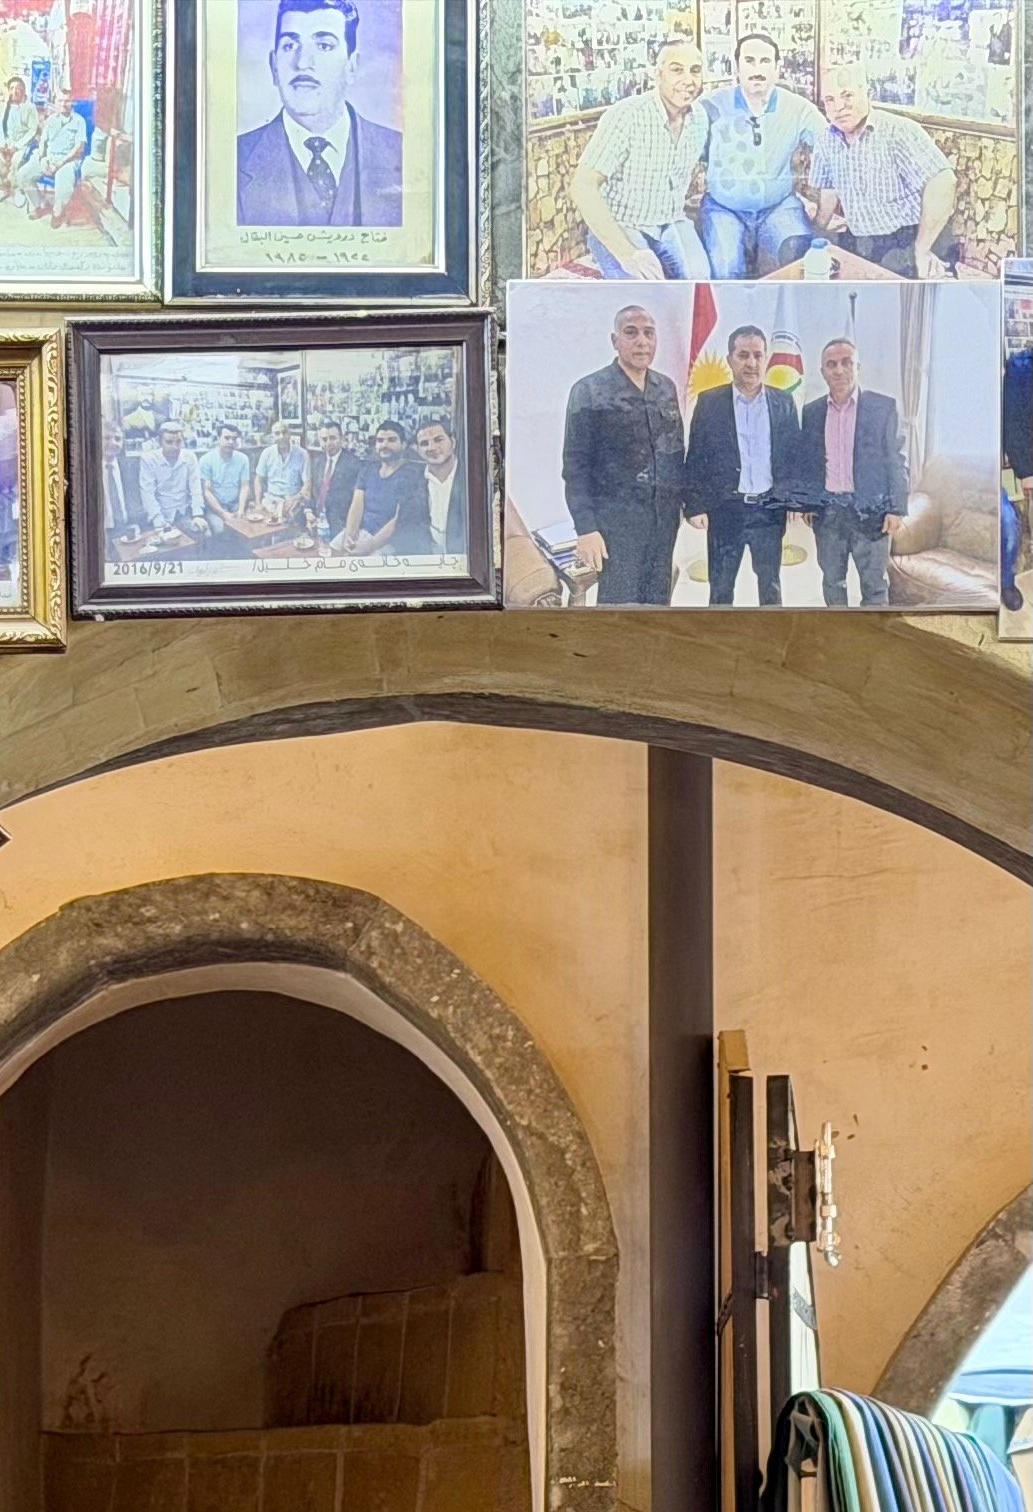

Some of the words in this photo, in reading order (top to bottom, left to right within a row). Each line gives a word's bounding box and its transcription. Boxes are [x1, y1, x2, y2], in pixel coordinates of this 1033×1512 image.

[239, 230, 272, 246] البقال
[360, 230, 388, 244] فتاح
[113, 561, 184, 577] 2016/9/21
